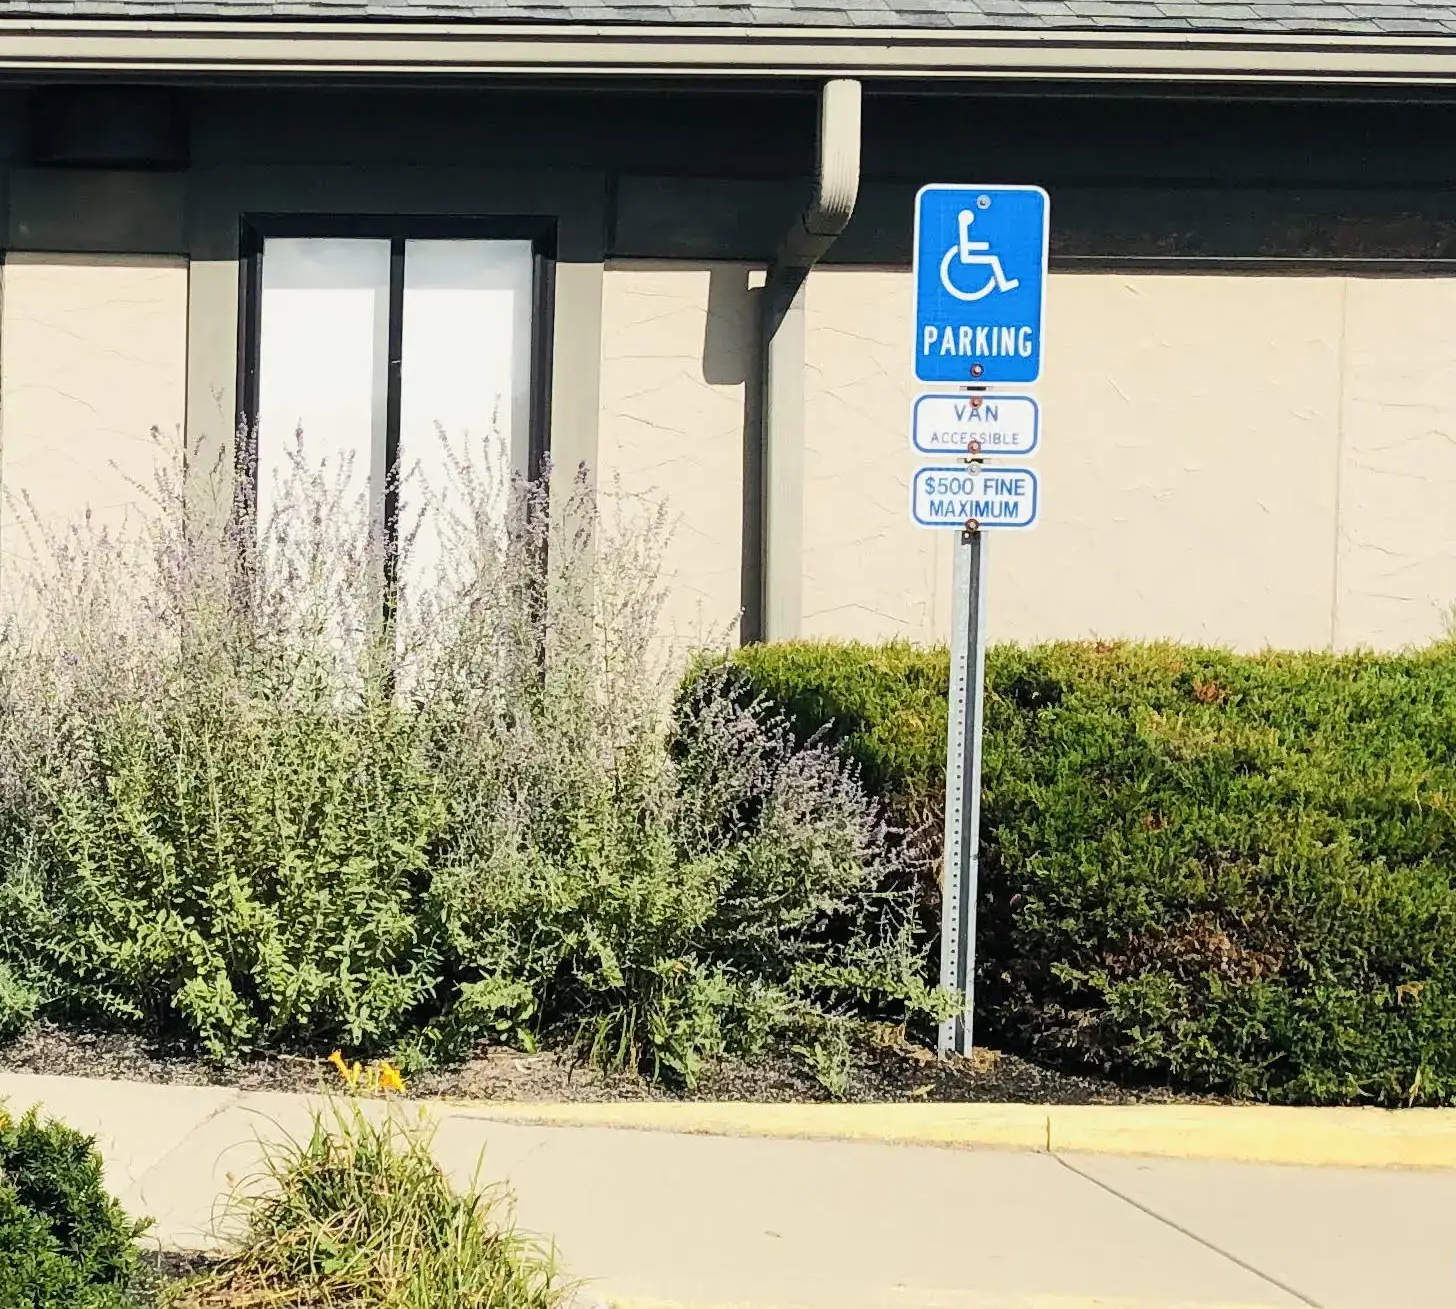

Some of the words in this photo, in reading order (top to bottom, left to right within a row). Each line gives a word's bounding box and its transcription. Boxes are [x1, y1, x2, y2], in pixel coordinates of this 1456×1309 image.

[923, 325, 1033, 358] PARKING
[954, 405, 999, 422] VAN
[930, 431, 1020, 445] ACCESSIBLE
[925, 478, 975, 496] $500
[983, 479, 1025, 496] FINE
[930, 500, 1019, 519] MAXIMUM
